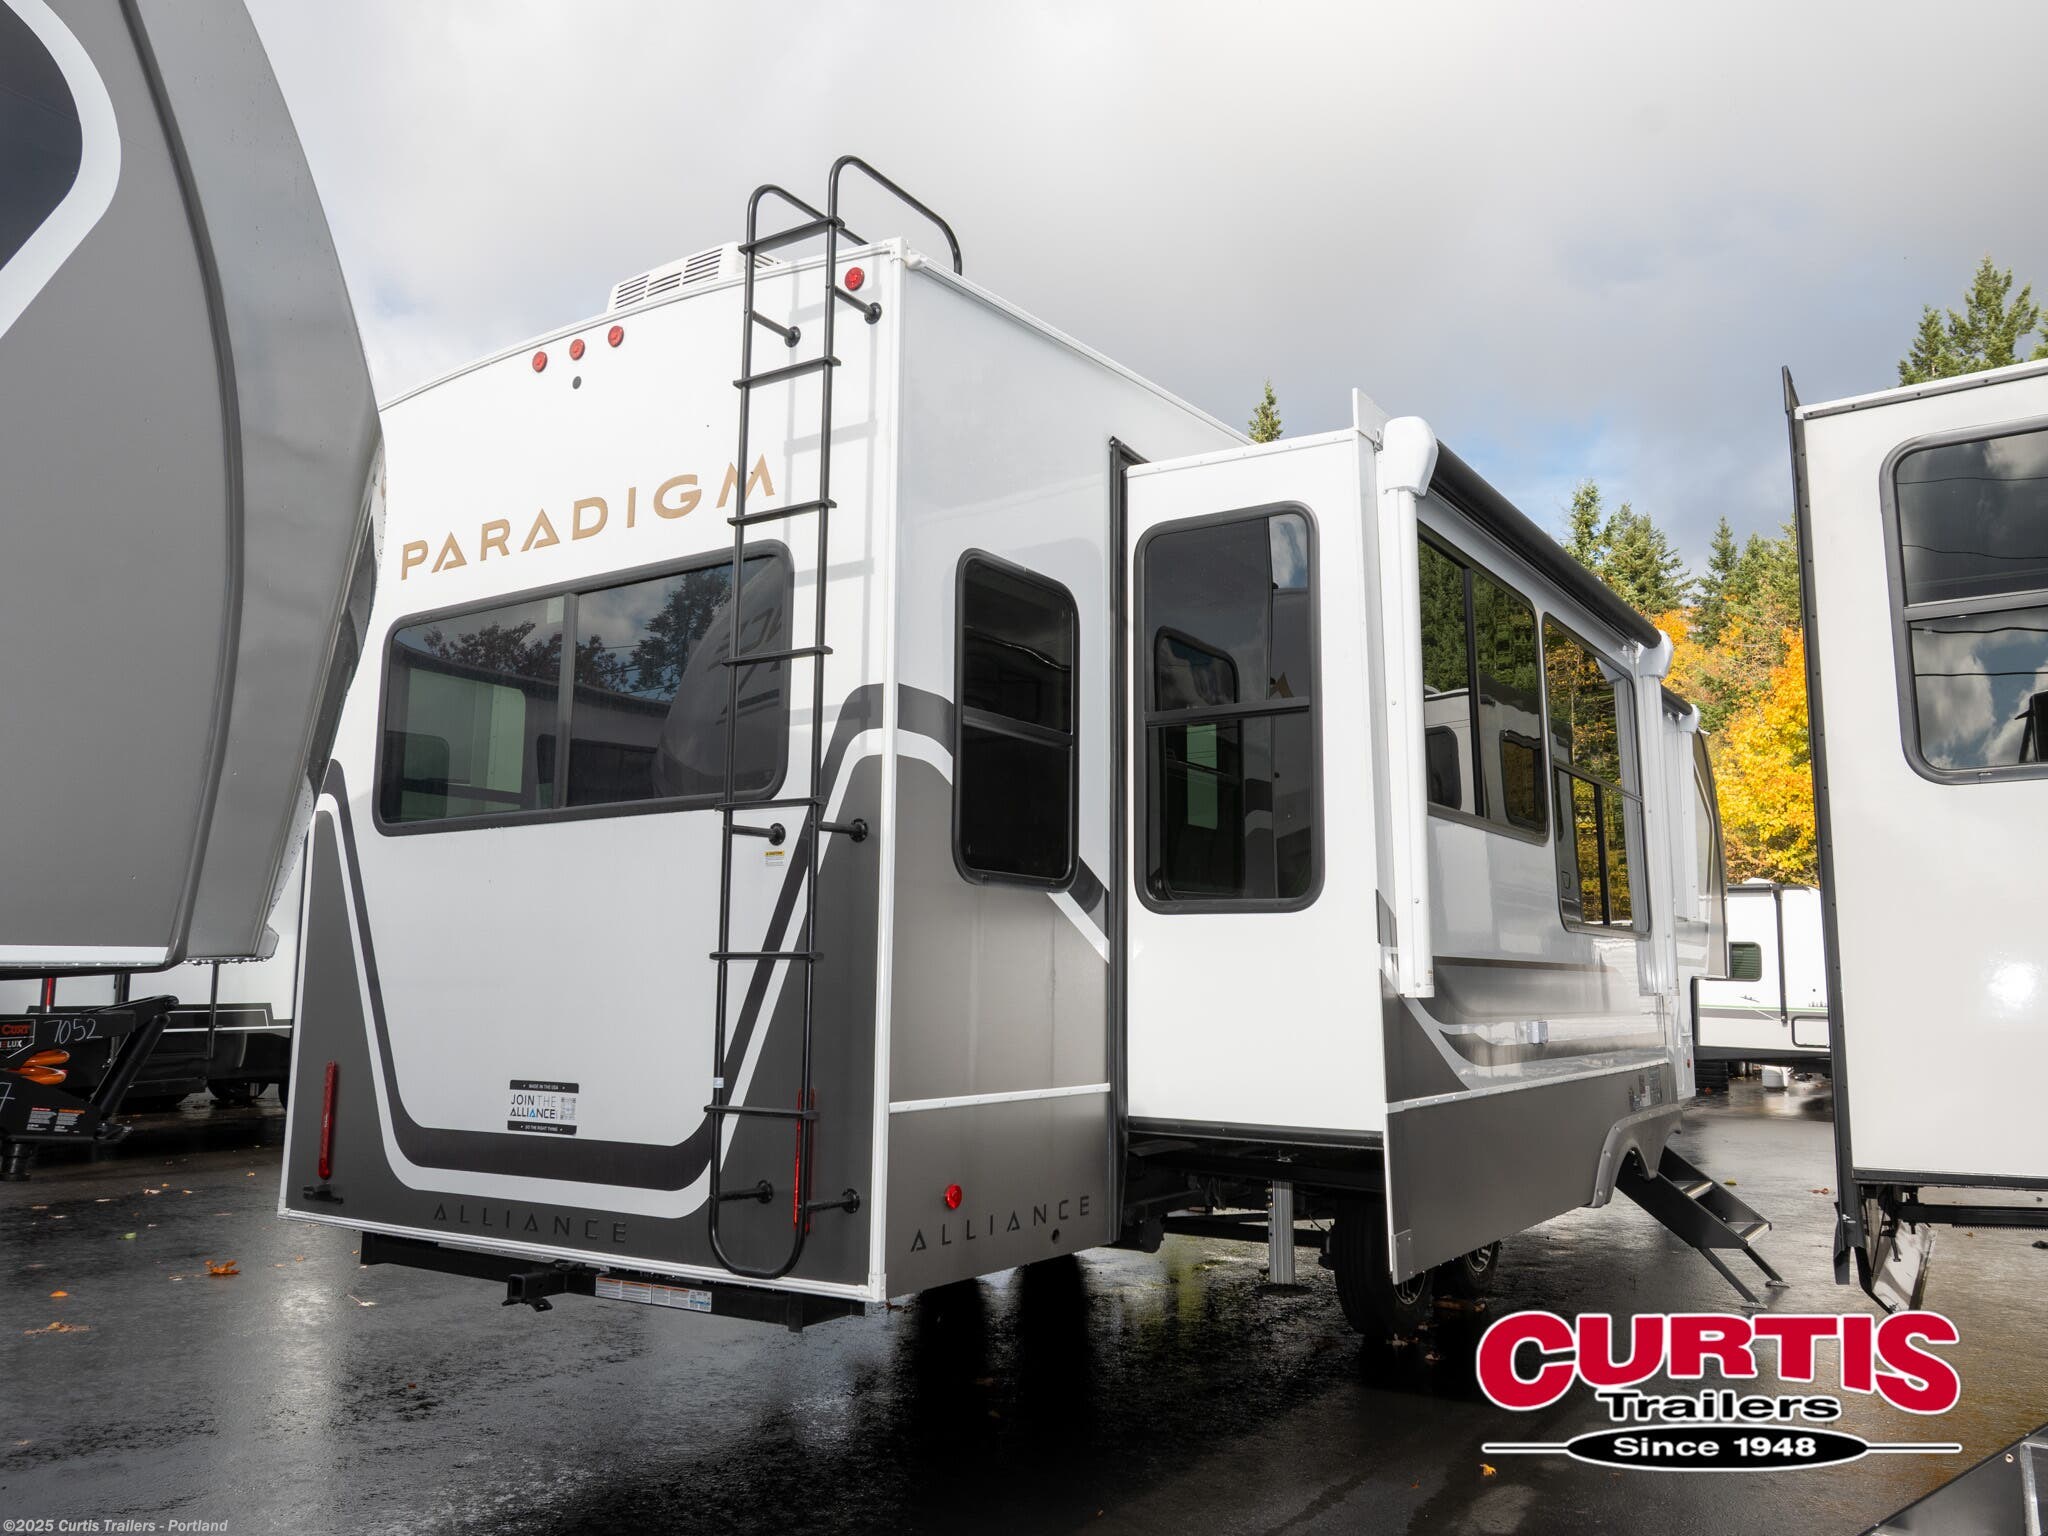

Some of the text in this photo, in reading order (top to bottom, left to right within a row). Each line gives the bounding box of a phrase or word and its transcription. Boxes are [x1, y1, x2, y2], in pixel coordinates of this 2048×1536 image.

[401, 453, 776, 581] PARADIGM
[44, 1018, 103, 1044] 7052
[510, 1107, 555, 1119] ALLIANCE
[511, 1094, 556, 1107] JOIN THE
[433, 1202, 627, 1243] ALLIANCE
[910, 1196, 1090, 1252] ALLIANCE
